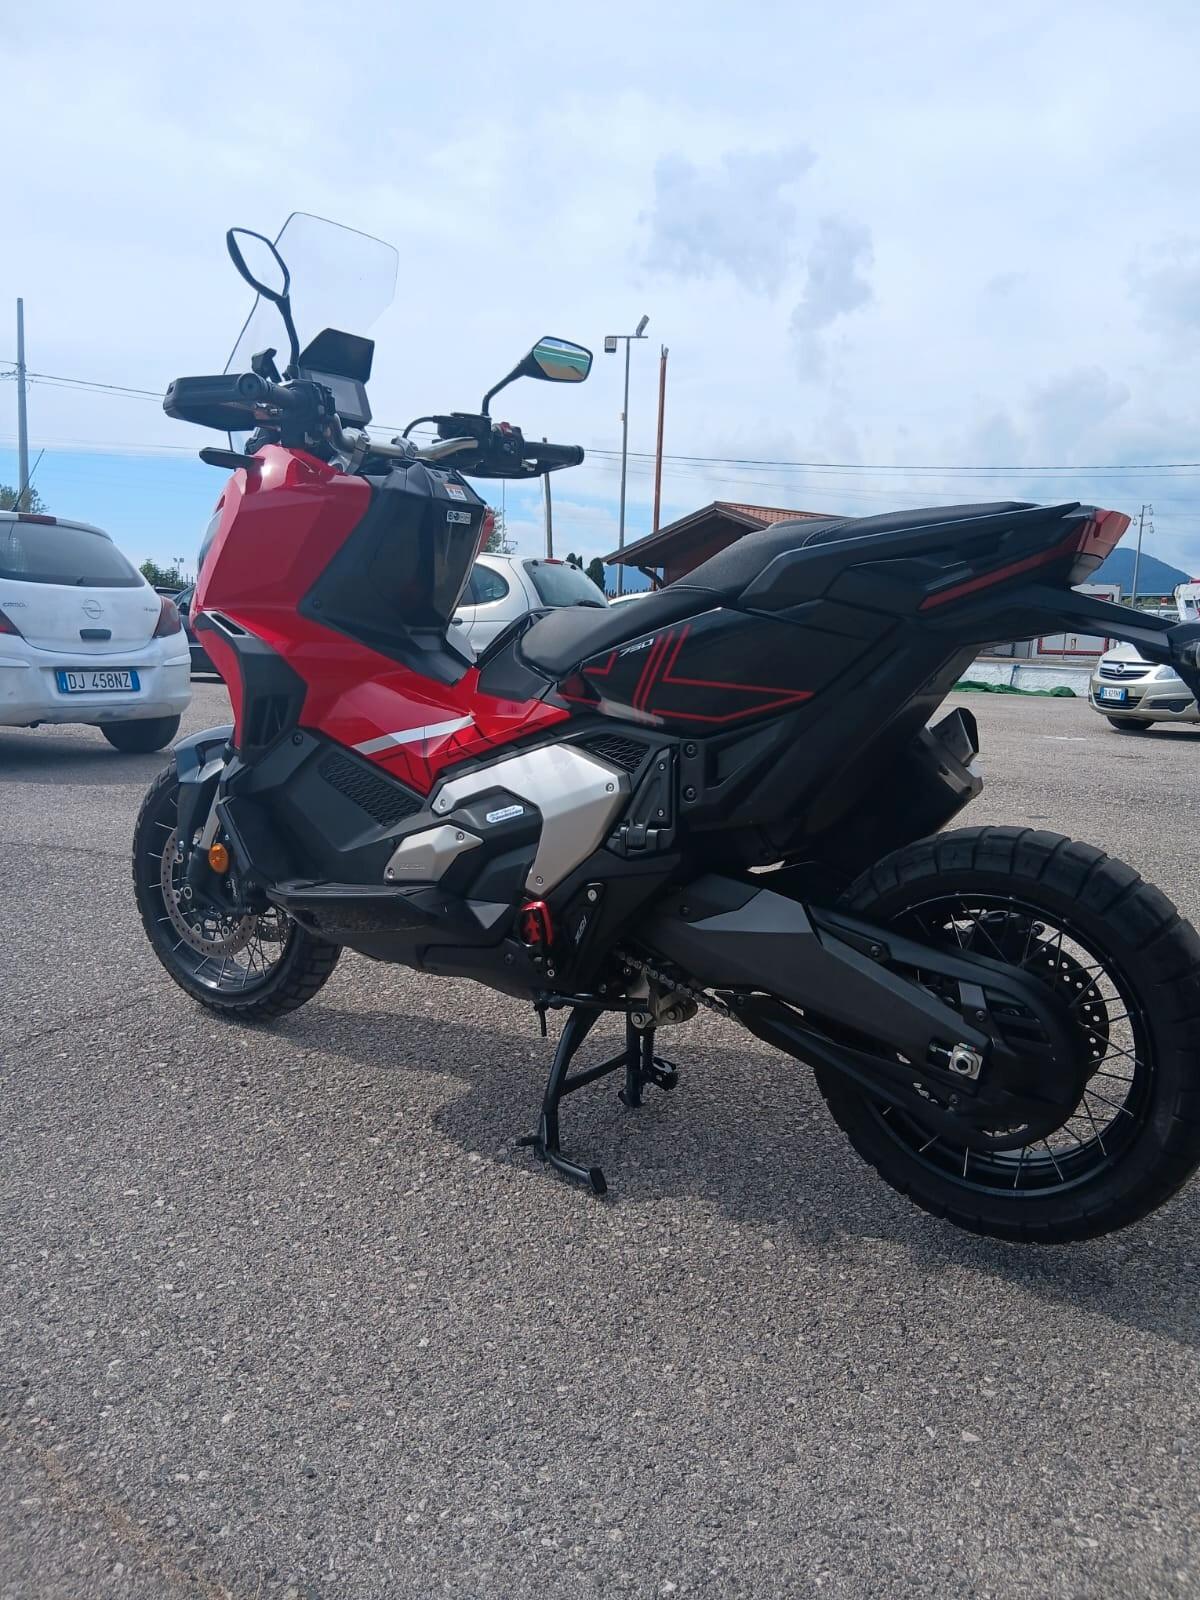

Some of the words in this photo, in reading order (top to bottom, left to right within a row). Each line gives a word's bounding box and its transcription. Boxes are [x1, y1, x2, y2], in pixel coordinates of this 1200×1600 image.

[619, 638, 655, 657] 750
[68, 673, 85, 689] DJ
[92, 672, 131, 688] 458NZ
